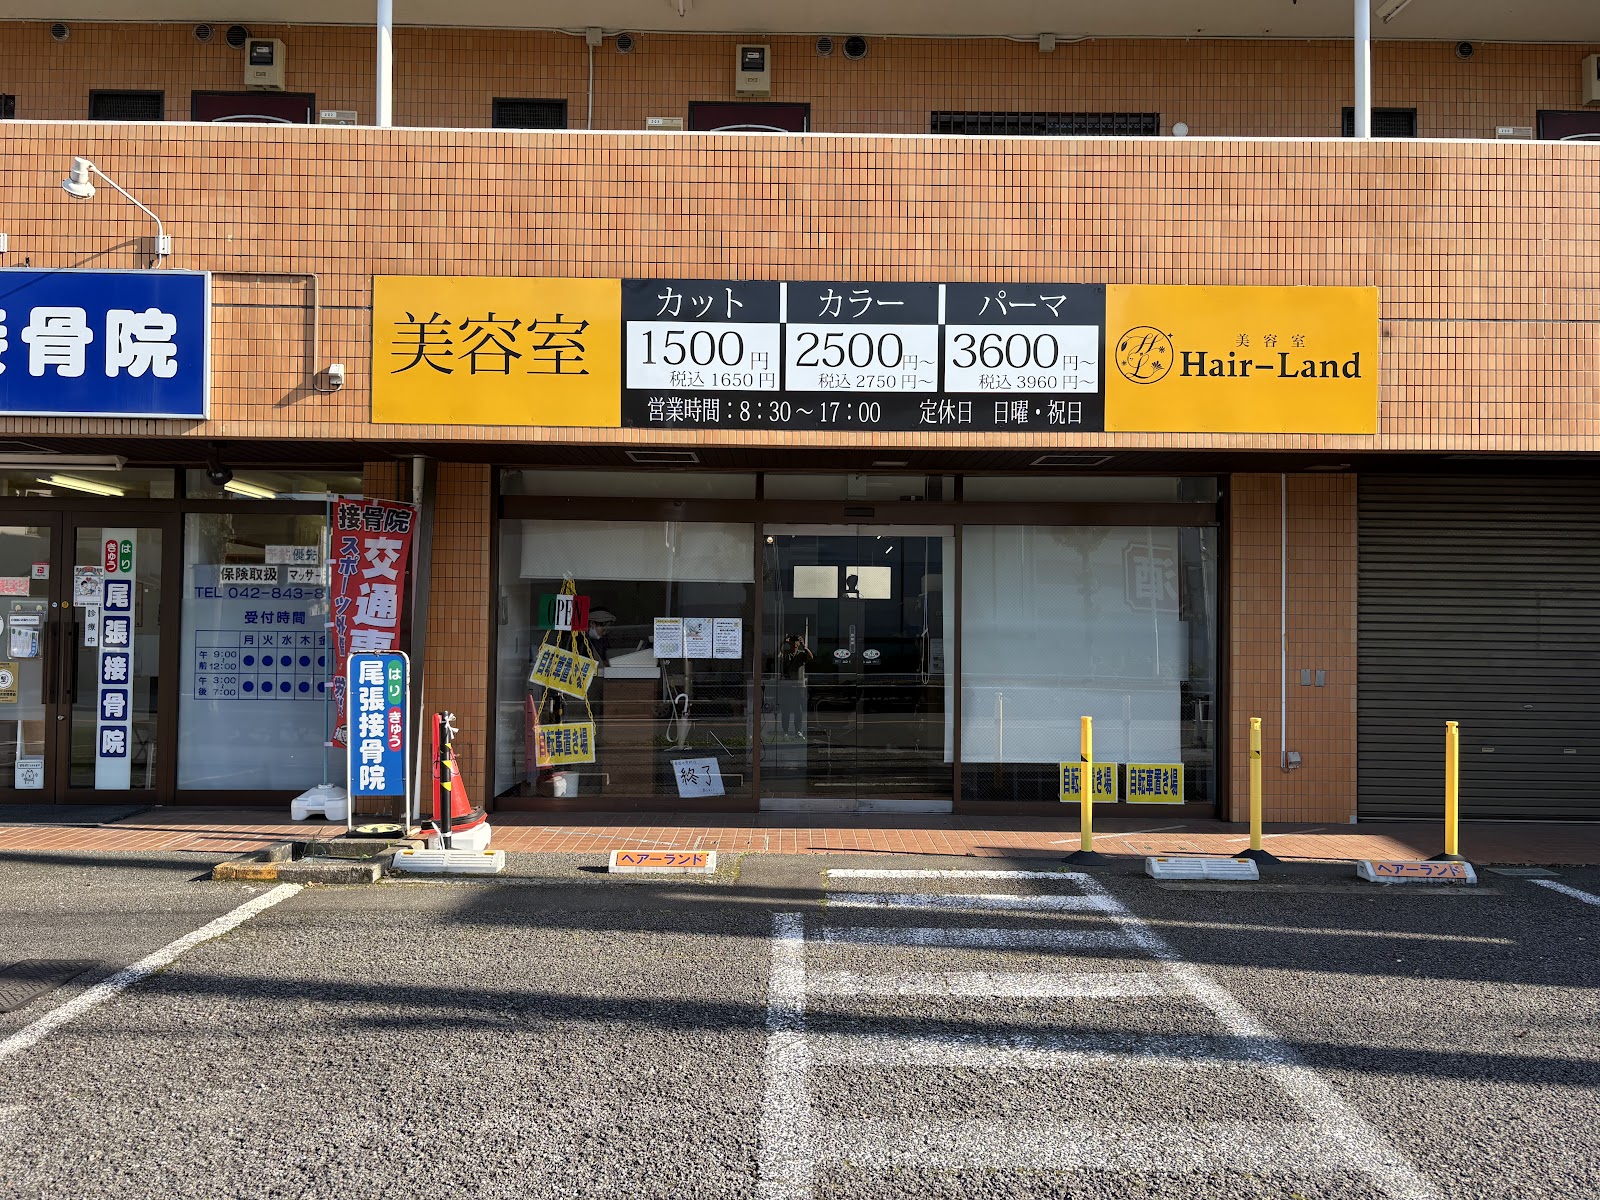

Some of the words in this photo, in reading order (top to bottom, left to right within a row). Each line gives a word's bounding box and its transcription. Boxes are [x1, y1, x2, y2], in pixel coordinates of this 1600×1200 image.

[656, 287, 743, 318] カット
[819, 289, 904, 318] カラー
[979, 290, 1067, 318] パーマ
[0, 308, 178, 378] 骨院
[391, 311, 590, 375] 美容室
[1236, 334, 1305, 348] 美容室
[1180, 351, 1362, 378] Hair-Land
[919, 398, 972, 424] 定休日
[994, 400, 1082, 425] 日曜・祝日
[338, 503, 412, 534] 接骨院
[107, 543, 117, 570] きゅう
[121, 543, 131, 569] はり
[221, 567, 278, 581] 保険取扱
[194, 586, 223, 598] TEL
[87, 609, 96, 644] 診療中
[244, 610, 306, 624] 受付時間
[548, 599, 582, 626] OPEN
[244, 635, 254, 645] 月
[263, 635, 273, 645] 火
[282, 635, 292, 645] 水
[300, 635, 311, 645] 木
[101, 583, 129, 754] 尾張接骨院
[388, 668, 402, 697] はり
[359, 660, 386, 791] 尾張接骨院
[388, 711, 402, 748] きゅう
[539, 728, 588, 758] 自転車置き場
[681, 765, 712, 786] 終了
[1063, 766, 1112, 795] 自転き場
[1130, 767, 1178, 796] 自転車置き場
[621, 853, 703, 866] ヘアーランド
[1377, 864, 1461, 877] ヘアーランド
